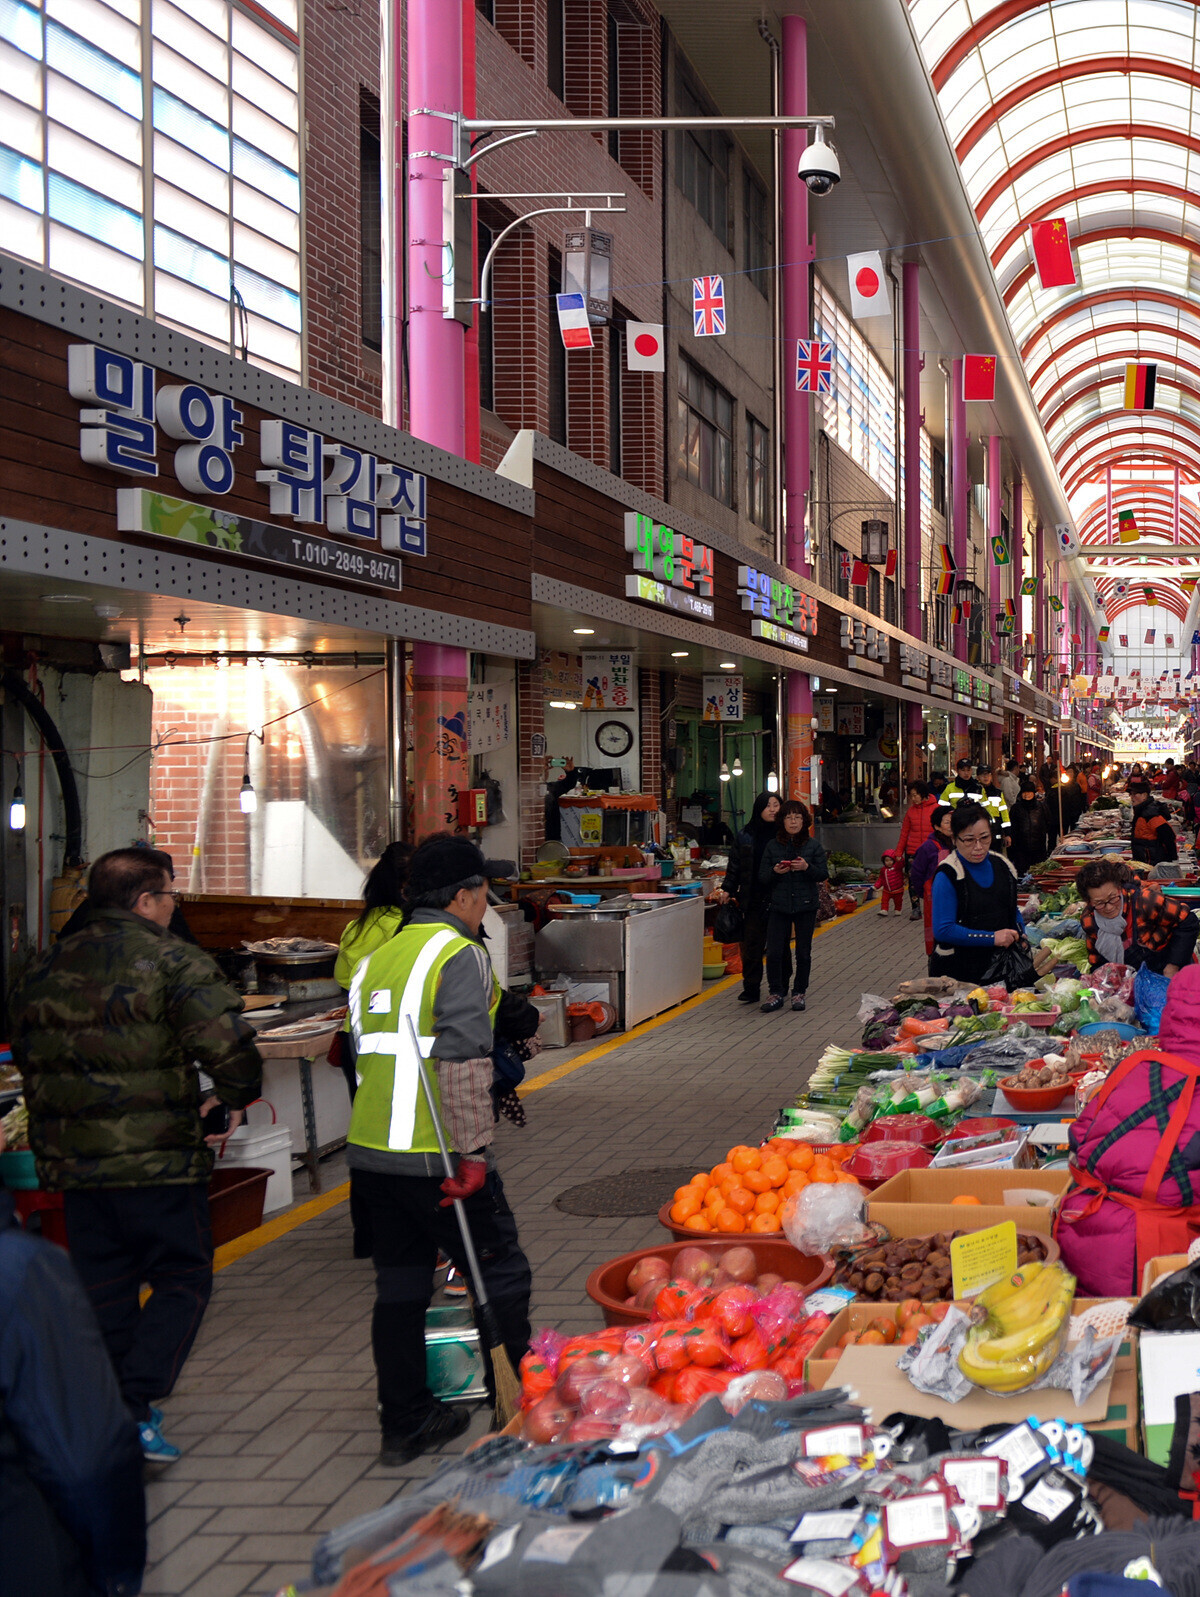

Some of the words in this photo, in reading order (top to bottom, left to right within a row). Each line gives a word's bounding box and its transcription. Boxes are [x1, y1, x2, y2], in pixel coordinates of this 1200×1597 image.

[90, 344, 244, 494] 밀양
[270, 419, 428, 557] 튀김집
[291, 538, 396, 582] T.010-2849-8474
[634, 513, 714, 597] 대영분식
[609, 654, 630, 665] 부일
[726, 688, 740, 718] 상회
